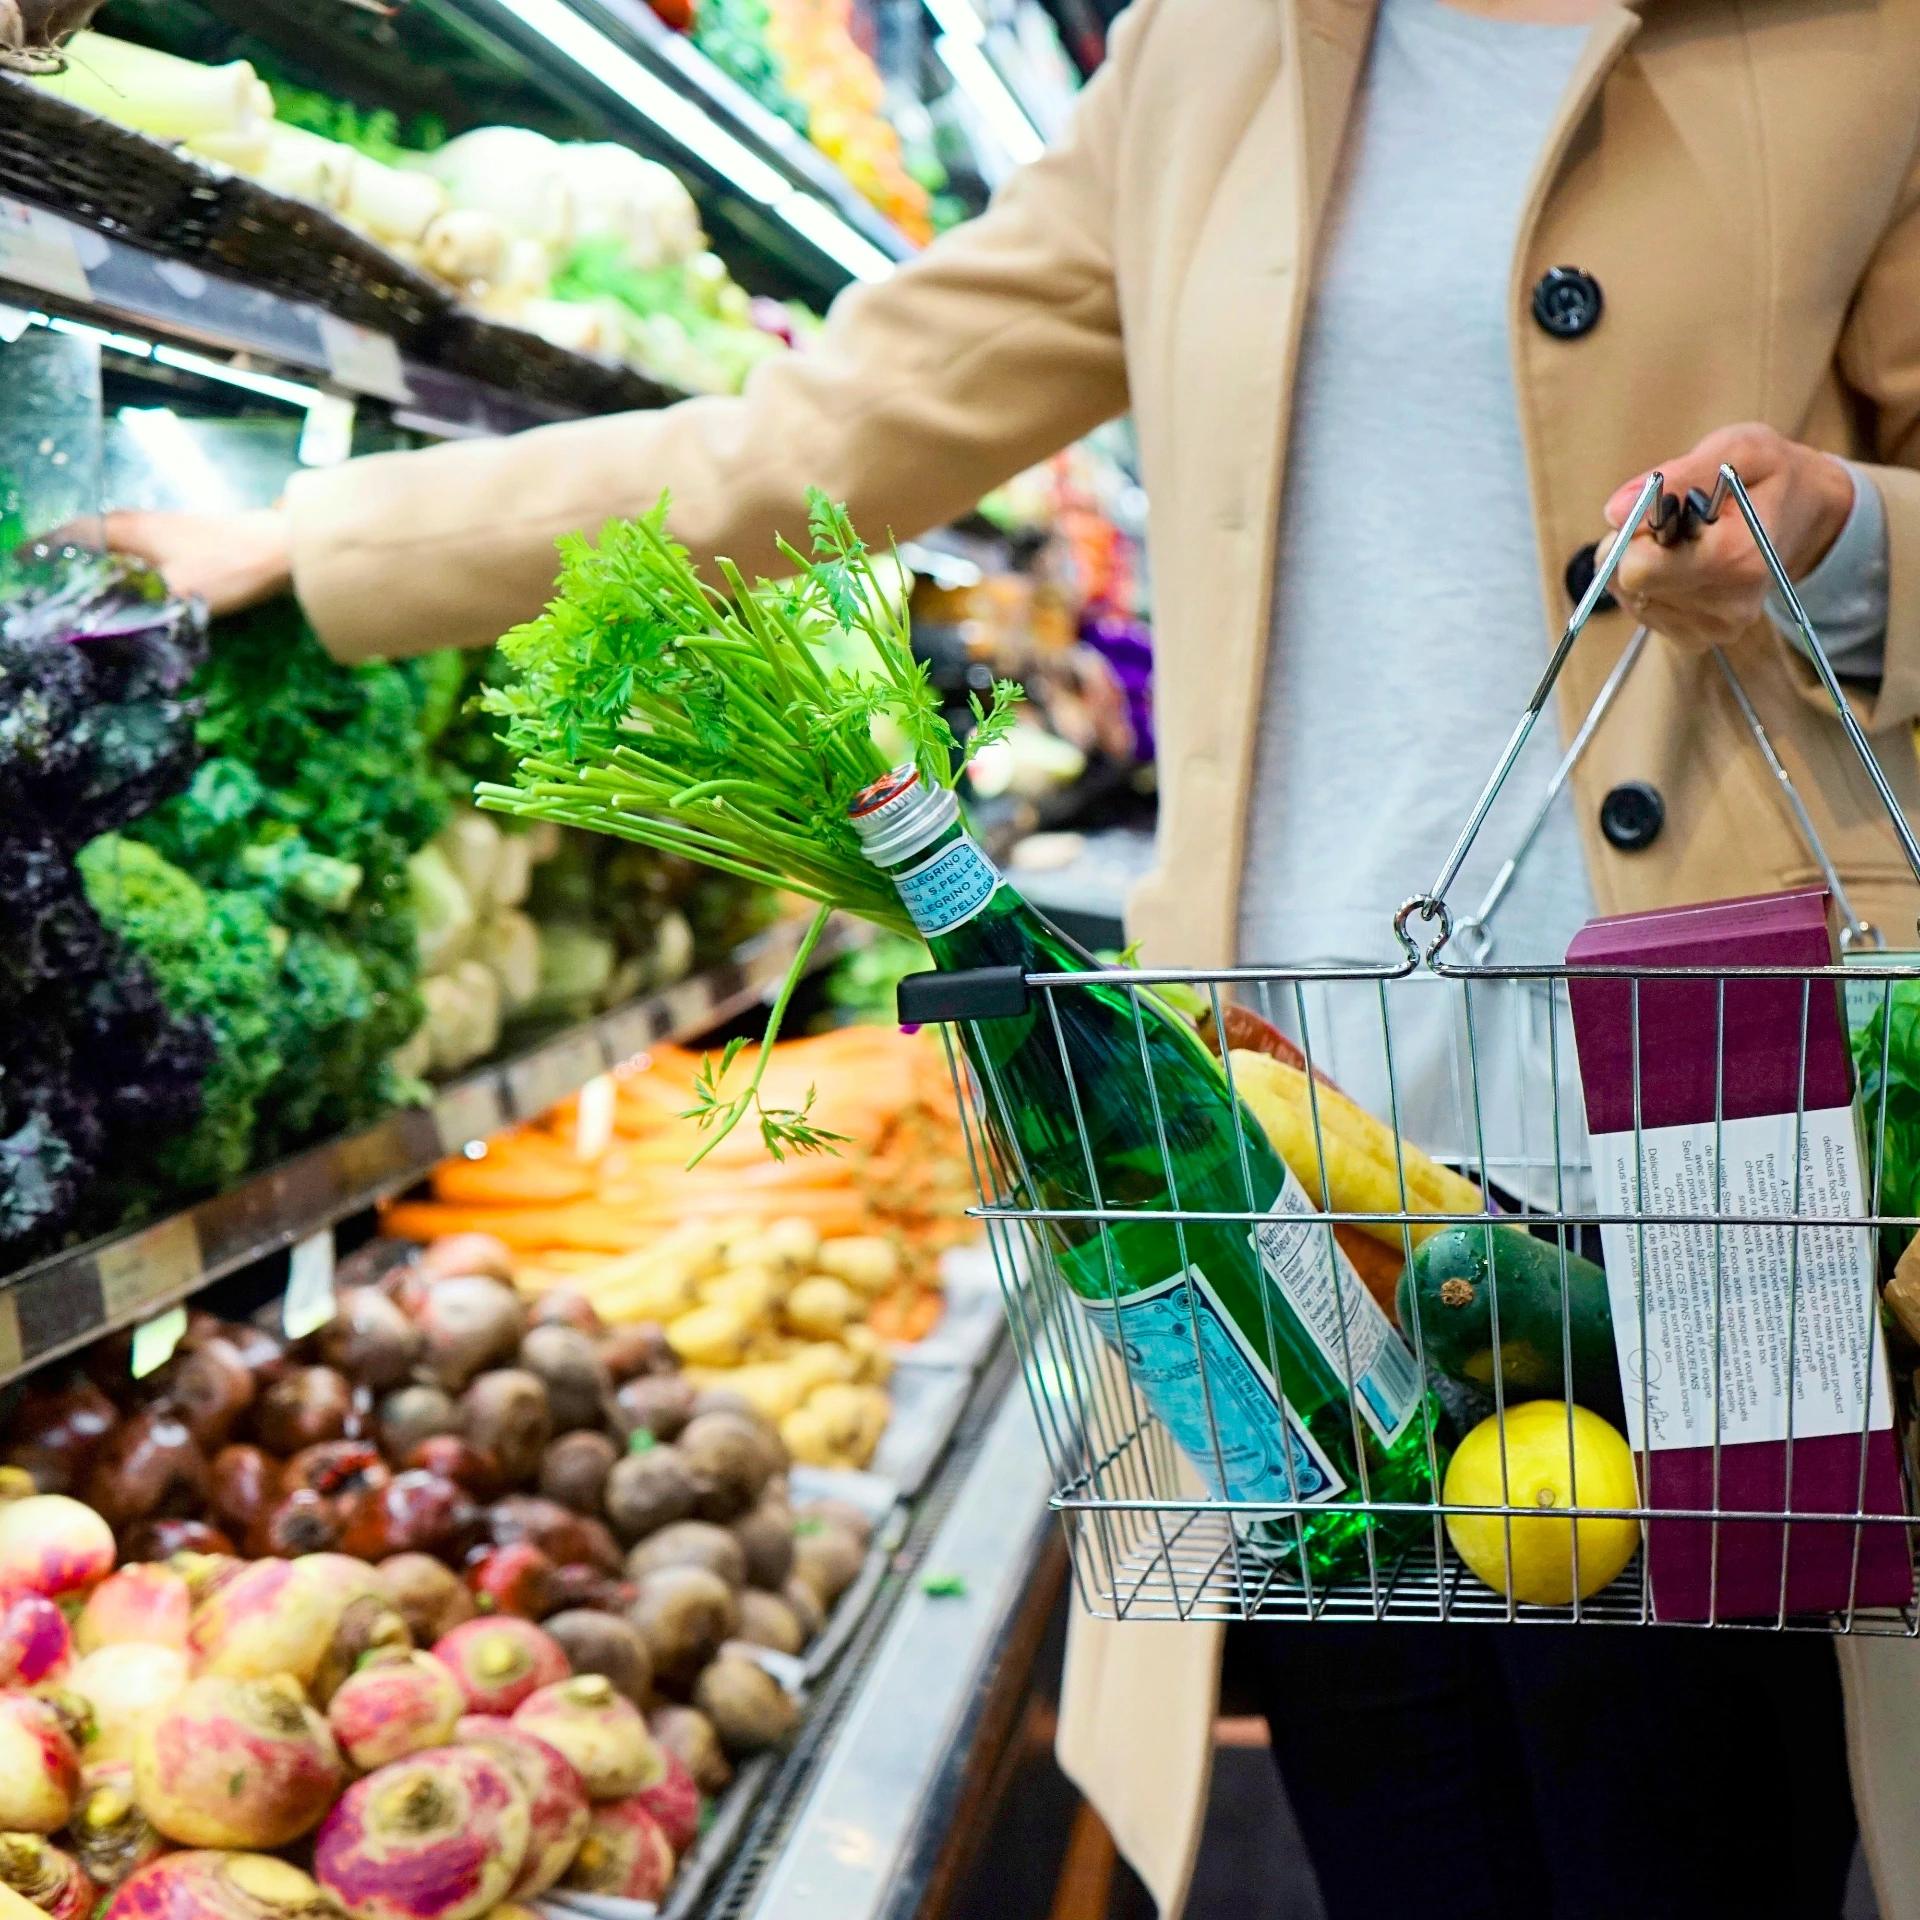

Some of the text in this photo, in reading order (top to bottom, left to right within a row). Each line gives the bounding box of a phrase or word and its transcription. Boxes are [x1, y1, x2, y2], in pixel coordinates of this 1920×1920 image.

[1681, 1139, 1694, 1162] Seul
[1704, 1144, 1714, 1157] de
[1821, 1134, 1836, 1176] delicious
[1834, 1143, 1845, 1155] At
[1615, 1157, 1626, 1180] vous
[1684, 1163, 1693, 1176] un
[1693, 1153, 1704, 1176] avec
[1754, 1159, 1765, 1175] but
[1764, 1152, 1777, 1179] these
[1802, 1163, 1813, 1172] &
[1834, 1156, 1849, 1188] Lesley
[1619, 1181, 1628, 1194] ne
[1695, 1177, 1709, 1201] soin,
[1755, 1176, 1769, 1202] really
[1778, 1177, 1790, 1186] A
[1804, 1173, 1816, 1191] her
[1636, 1165, 1656, 1231] accompags
[1673, 1171, 1689, 1217] supérieu
[1684, 1177, 1700, 1211] produit
[1720, 1190, 1733, 1217] Stow
[1737, 1193, 1749, 1217] snac
[1766, 1181, 1782, 1214] unique
[1780, 1188, 1794, 1221] CRIS
[1806, 1191, 1819, 1217] team
[1817, 1186, 1826, 1202] are
[1619, 1195, 1635, 1232] pouez
[1700, 1202, 1709, 1215] en
[1760, 1203, 1773, 1229] she
[1797, 1208, 1809, 1230] frm
[1819, 1204, 1831, 1231] mae
[1830, 1204, 1844, 1234] The
[1647, 1232, 1658, 1245] de
[1680, 1223, 1695, 1258] pouvait
[1691, 1212, 1705, 1247] aison
[1703, 1220, 1716, 1249] etites
[1773, 1220, 1788, 1255] ackers
[1265, 1230, 1294, 1262] Valeur
[1625, 1233, 1637, 1254] plus
[1744, 1246, 1754, 1255] &
[1764, 1231, 1777, 1257] when
[1800, 1231, 1814, 1266] scratch
[1813, 1243, 1825, 1259] the
[1823, 1233, 1834, 1253] with
[1834, 1235, 1849, 1275] fabulous
[1629, 1255, 1639, 1278] vous
[1648, 1246, 1664, 1294] trempette,
[1694, 1248, 1711, 1287] fabriqué
[1728, 1245, 1741, 1275] Foods
[1745, 1256, 1755, 1273] are
[1778, 1257, 1788, 1273] are
[1814, 1260, 1827, 1281] only
[1826, 1255, 1836, 1277] care
[1847, 1245, 1860, 1275] Foods
[1686, 1259, 1701, 1302] satisfaire
[1720, 1265, 1734, 1304] fabuleux
[1743, 1159, 1782, 1397] cheese or apasto. We are addicted to this yummy
[1748, 1274, 1758, 1296] sure
[1766, 1258, 1781, 1292] topped
[1803, 1267, 1818, 1294] using
[1829, 1278, 1839, 1287] in
[1852, 1277, 1861, 1291] we
[1647, 1147, 1695, 1429] Délicieux au nurel, ces craquelins sont irrésistibles lorsqu'ils
[1663, 1186, 1700, 1390] CRAEZ POUR CES FINS CRAQUELINS
[1701, 1288, 1711, 1311] avec
[1732, 1276, 1745, 1304] adore
[1817, 1283, 1828, 1303] way
[1838, 1277, 1853, 1306] crisps
[1656, 1295, 1666, 1309] de
[1749, 1297, 1760, 1315] you
[1772, 1292, 1784, 1313] with
[1809, 1295, 1818, 1311] our
[1821, 1303, 1832, 1313] to
[1830, 1289, 1842, 1315] small
[1854, 1293, 1865, 1313] love
[1656, 1310, 1672, 1349] fromage
[1691, 1303, 1705, 1334] Lesley
[1704, 1312, 1717, 1331] des
[1724, 1306, 1741, 1355] craquelins
[1734, 1305, 1751, 1347] fabriquer
[1753, 1316, 1764, 1332] will
[1773, 1314, 1785, 1334] your
[1811, 1312, 1823, 1338] finest
[1823, 1315, 1836, 1341] make
[1844, 1307, 1856, 1330] from
[1697, 1335, 1707, 1346] et
[1756, 1333, 1766, 1346] be
[1855, 1314, 1870, 1350] making
[1664, 1350, 1673, 1363] ou
[1698, 1347, 1708, 1365] son
[1742, 1348, 1753, 1359] et
[1845, 1331, 1862, 1369] Lesley's
[1723, 1368, 1734, 1381] de
[1732, 1355, 1744, 1377] sont
[1743, 1361, 1754, 1383] vous
[1791, 1357, 1804, 1378] their
[1826, 1351, 1840, 1376] great
[1747, 1384, 1759, 1406] offrir
[1794, 1379, 1805, 1400] own
[1829, 1378, 1844, 1414] product
[1852, 1370, 1866, 1405] kitchen
[1734, 1378, 1750, 1422] fabriqués
